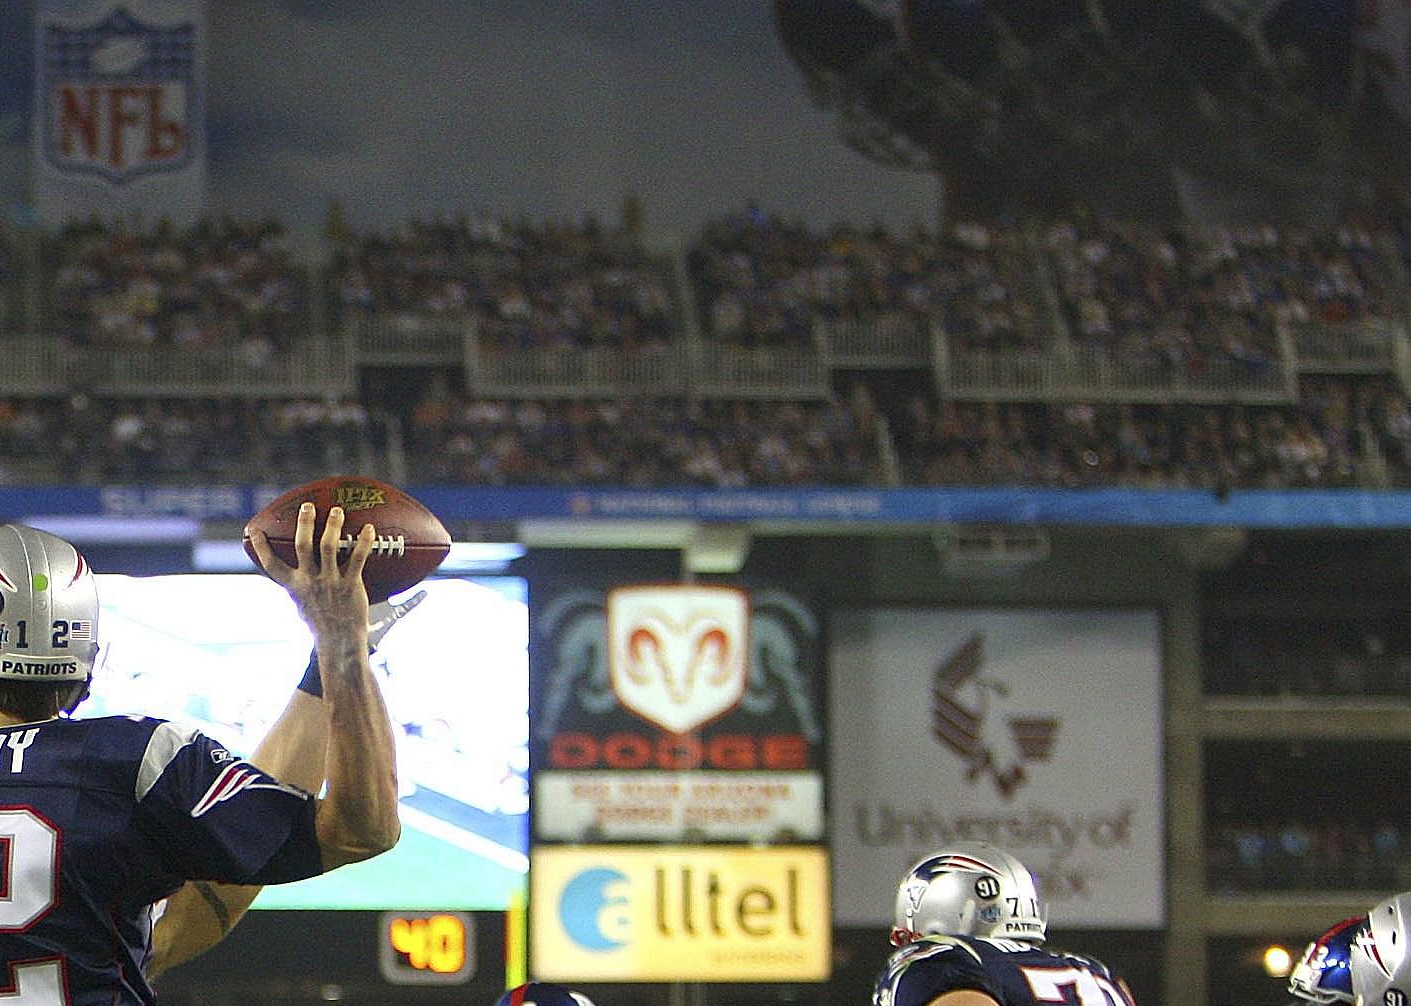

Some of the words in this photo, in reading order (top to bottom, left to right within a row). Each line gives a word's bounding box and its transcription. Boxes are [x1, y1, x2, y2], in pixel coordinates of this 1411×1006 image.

[55, 85, 185, 169] NFL
[1, 660, 78, 676] PATRIOTS
[547, 733, 807, 770] DODGE
[977, 879, 998, 897] 91
[390, 914, 466, 973] 40
